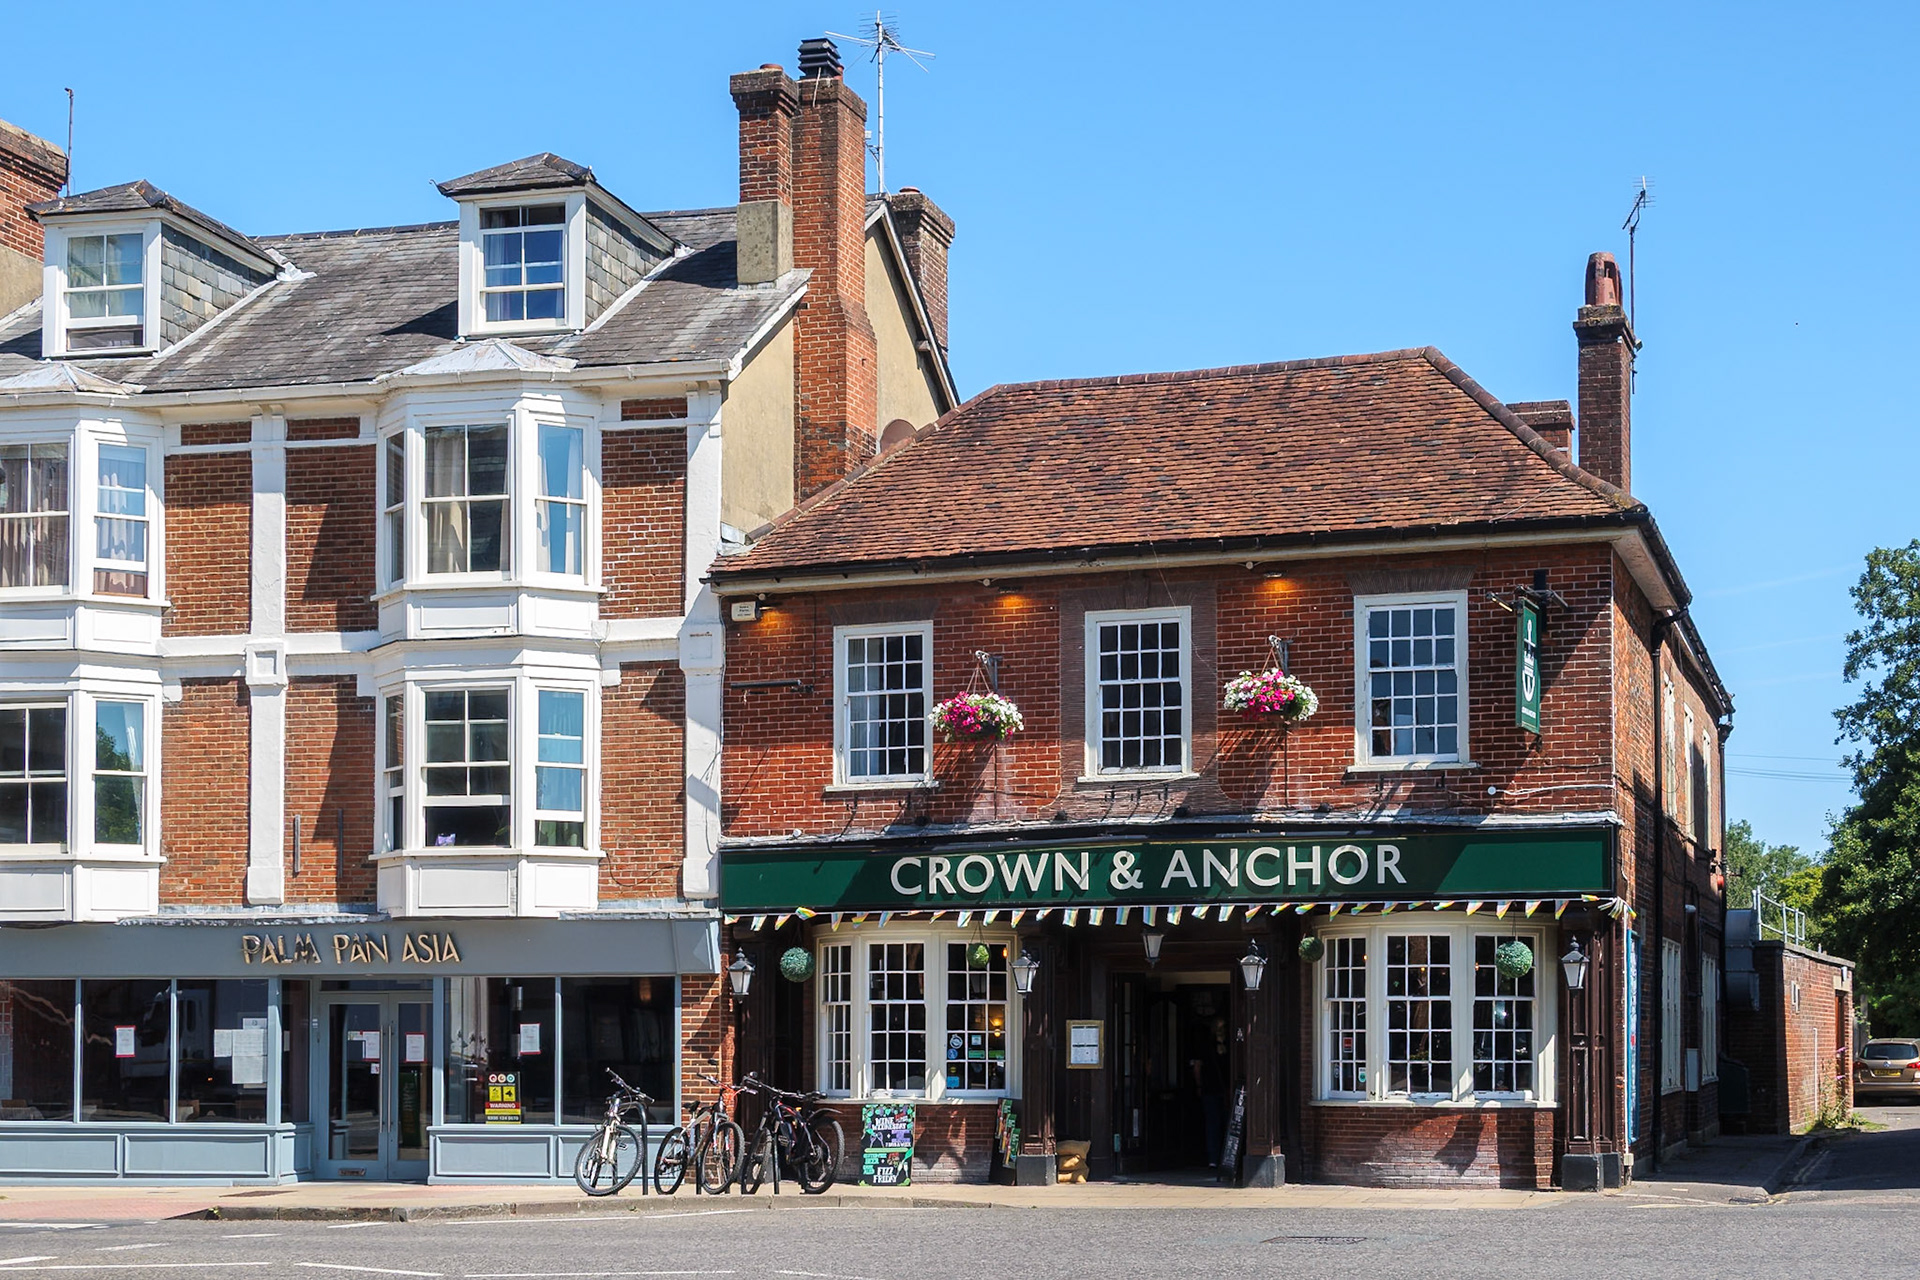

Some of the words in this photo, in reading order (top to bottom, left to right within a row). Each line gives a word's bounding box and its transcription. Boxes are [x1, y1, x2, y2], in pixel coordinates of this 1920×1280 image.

[890, 852, 1089, 895] CROWN
[1110, 850, 1143, 890] &
[1161, 845, 1407, 888] ANCHOR
[241, 933, 321, 964] PALM
[332, 933, 389, 964] PAN
[402, 933, 461, 963] ASIA
[875, 1116, 894, 1125] WINE
[872, 1123, 906, 1131] WEDNESDAY
[877, 1167, 894, 1175] FIZZ
[873, 1175, 897, 1183] FRIDAY
